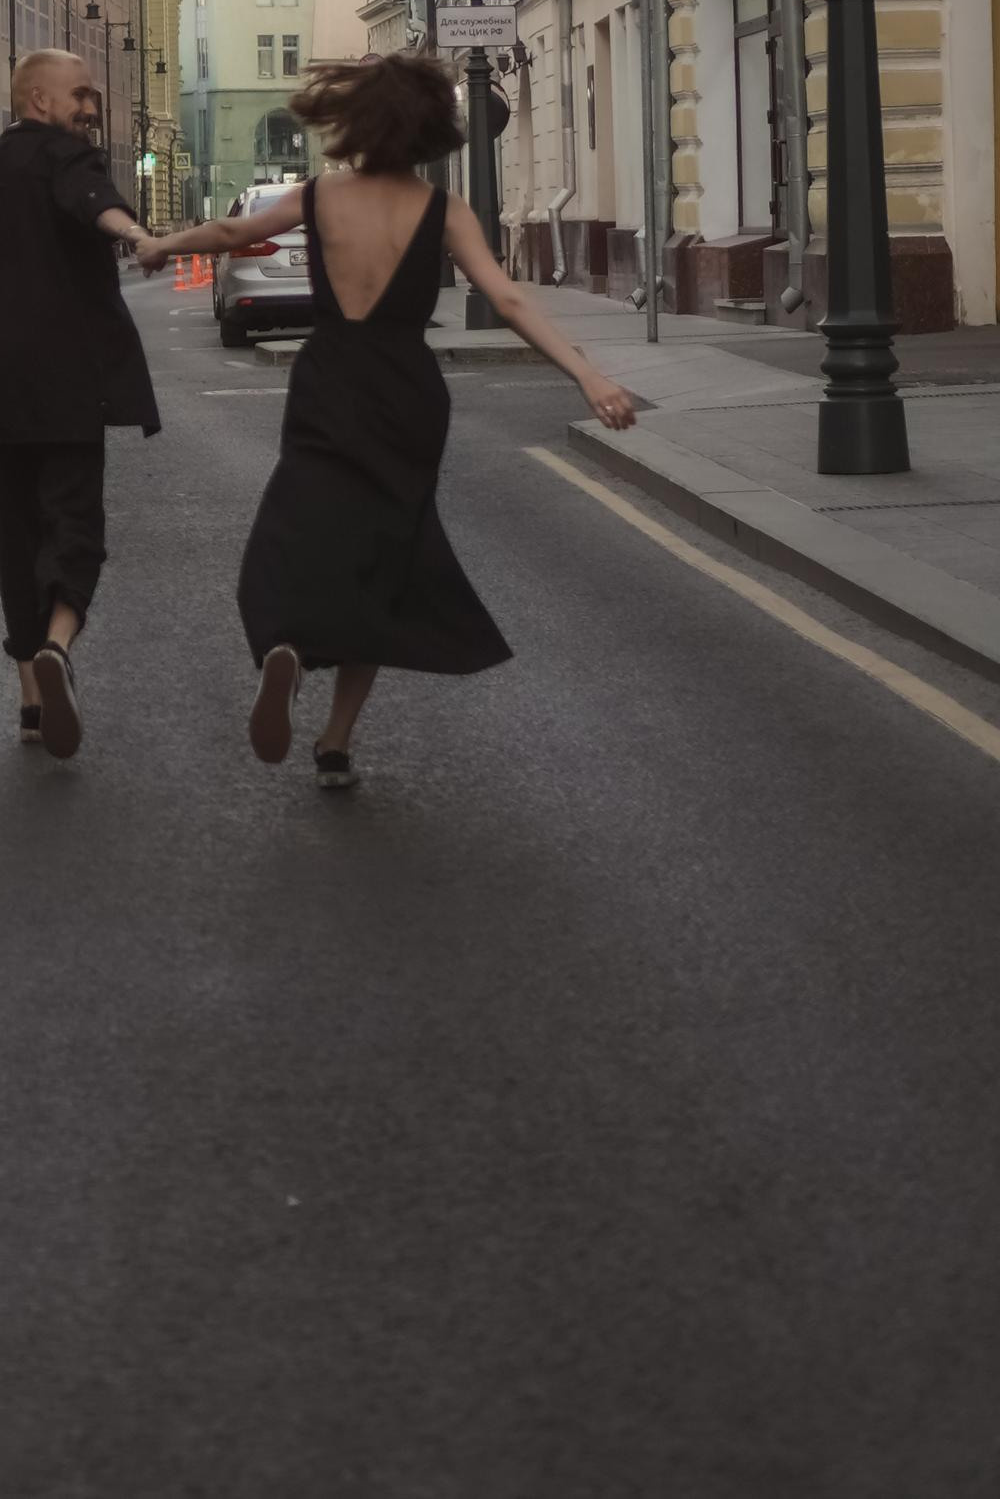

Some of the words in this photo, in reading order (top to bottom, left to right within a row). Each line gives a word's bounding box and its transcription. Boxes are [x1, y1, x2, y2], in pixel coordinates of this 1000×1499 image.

[441, 18, 458, 27] Для
[460, 16, 512, 27] служебных
[450, 28, 466, 37] а/м
[469, 28, 488, 37] ЦИК
[490, 28, 503, 36] РФ
